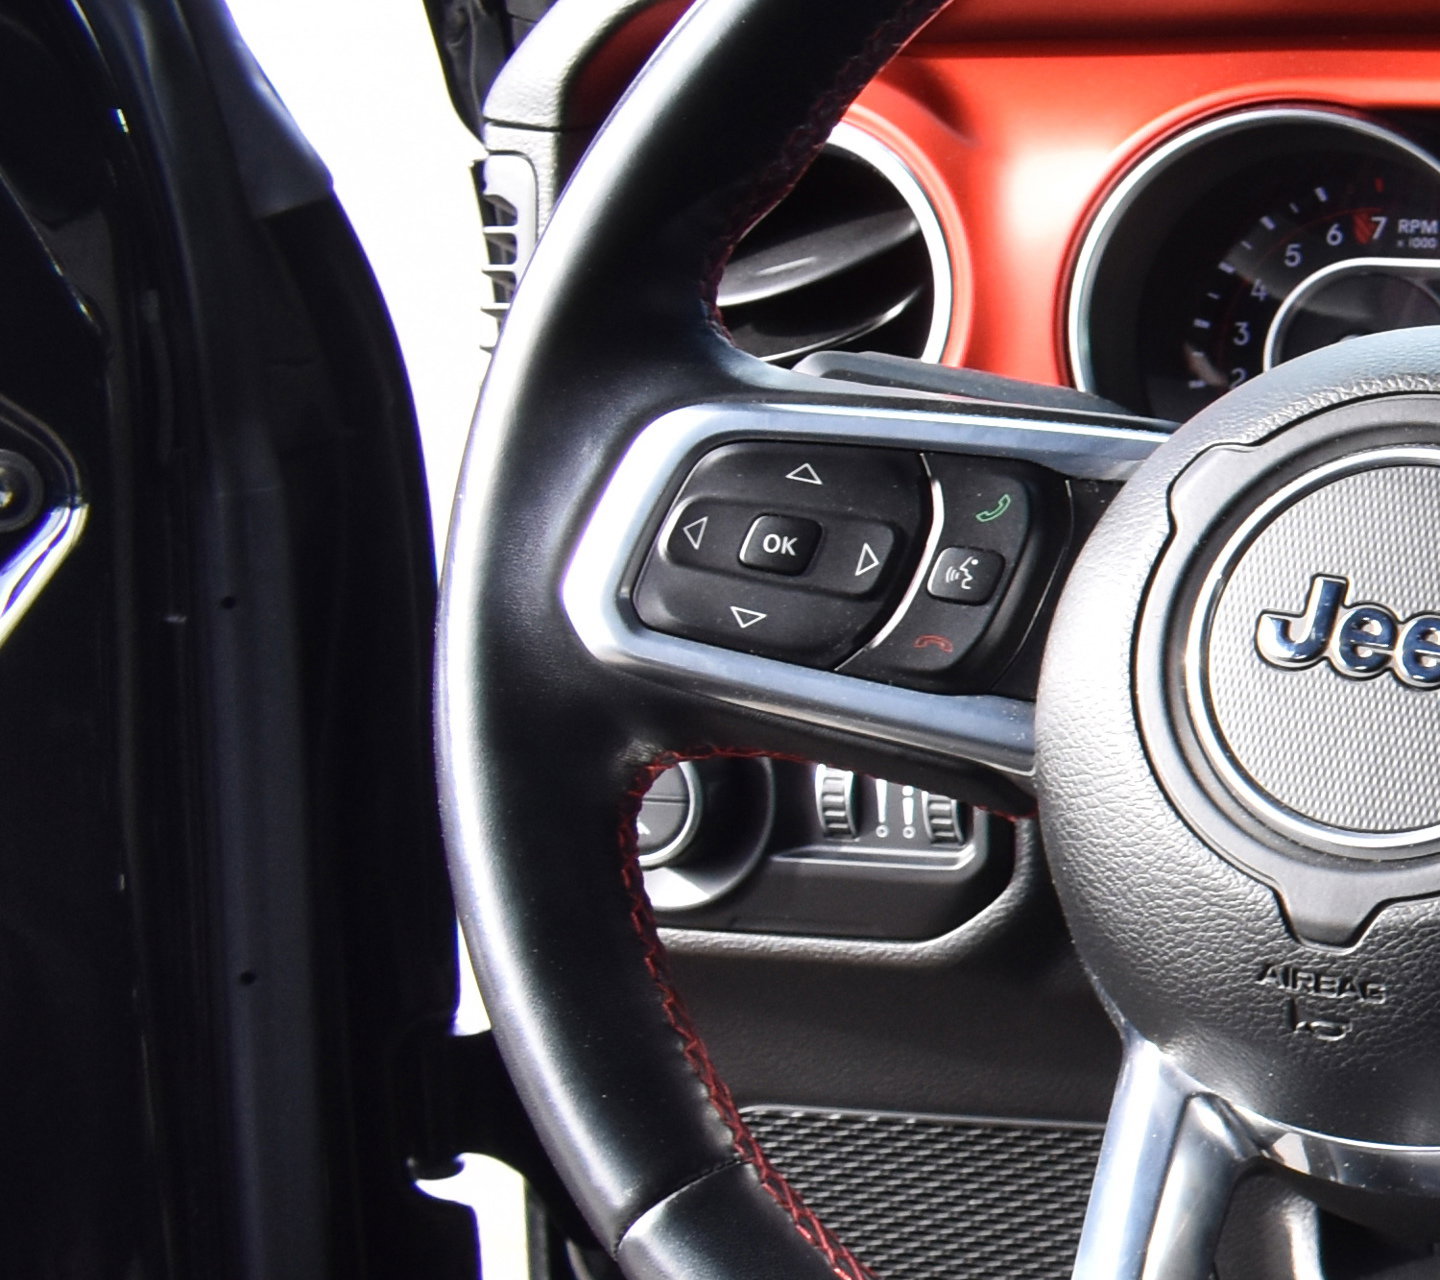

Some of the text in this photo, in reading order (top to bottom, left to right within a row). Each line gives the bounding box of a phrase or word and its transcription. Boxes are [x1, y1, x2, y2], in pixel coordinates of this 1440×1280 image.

[1325, 223, 1344, 247] 6
[1370, 216, 1388, 241] 7
[1396, 218, 1439, 235] RPM
[1407, 236, 1438, 249] 1000
[1283, 243, 1303, 268] 5
[1250, 279, 1269, 302] 4
[1232, 321, 1251, 346] 3
[1229, 366, 1247, 388] 2
[762, 533, 797, 558] OK
[1256, 964, 1388, 1004] AIRBAG
